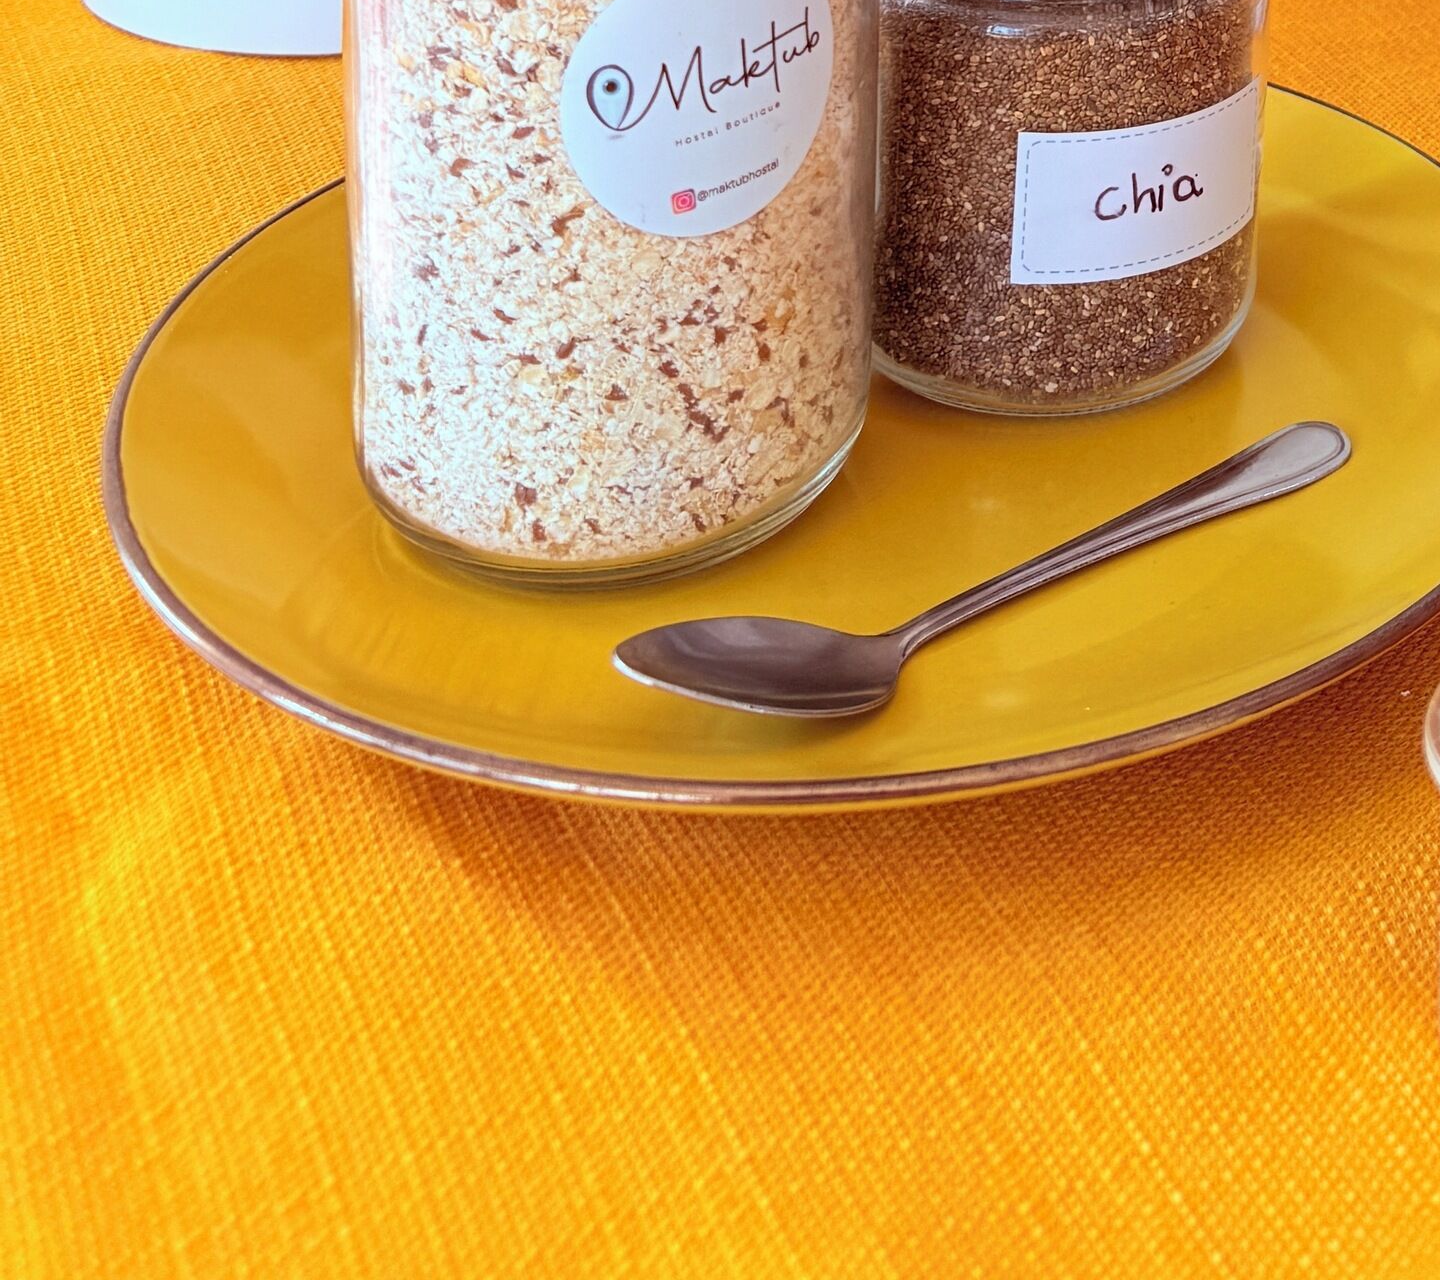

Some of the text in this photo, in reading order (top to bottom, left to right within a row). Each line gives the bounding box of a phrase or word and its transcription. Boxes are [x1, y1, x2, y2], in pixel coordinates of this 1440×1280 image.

[630, 6, 820, 131] Maktub
[725, 100, 782, 131] Boutique
[696, 158, 780, 203] @maktubhostal
